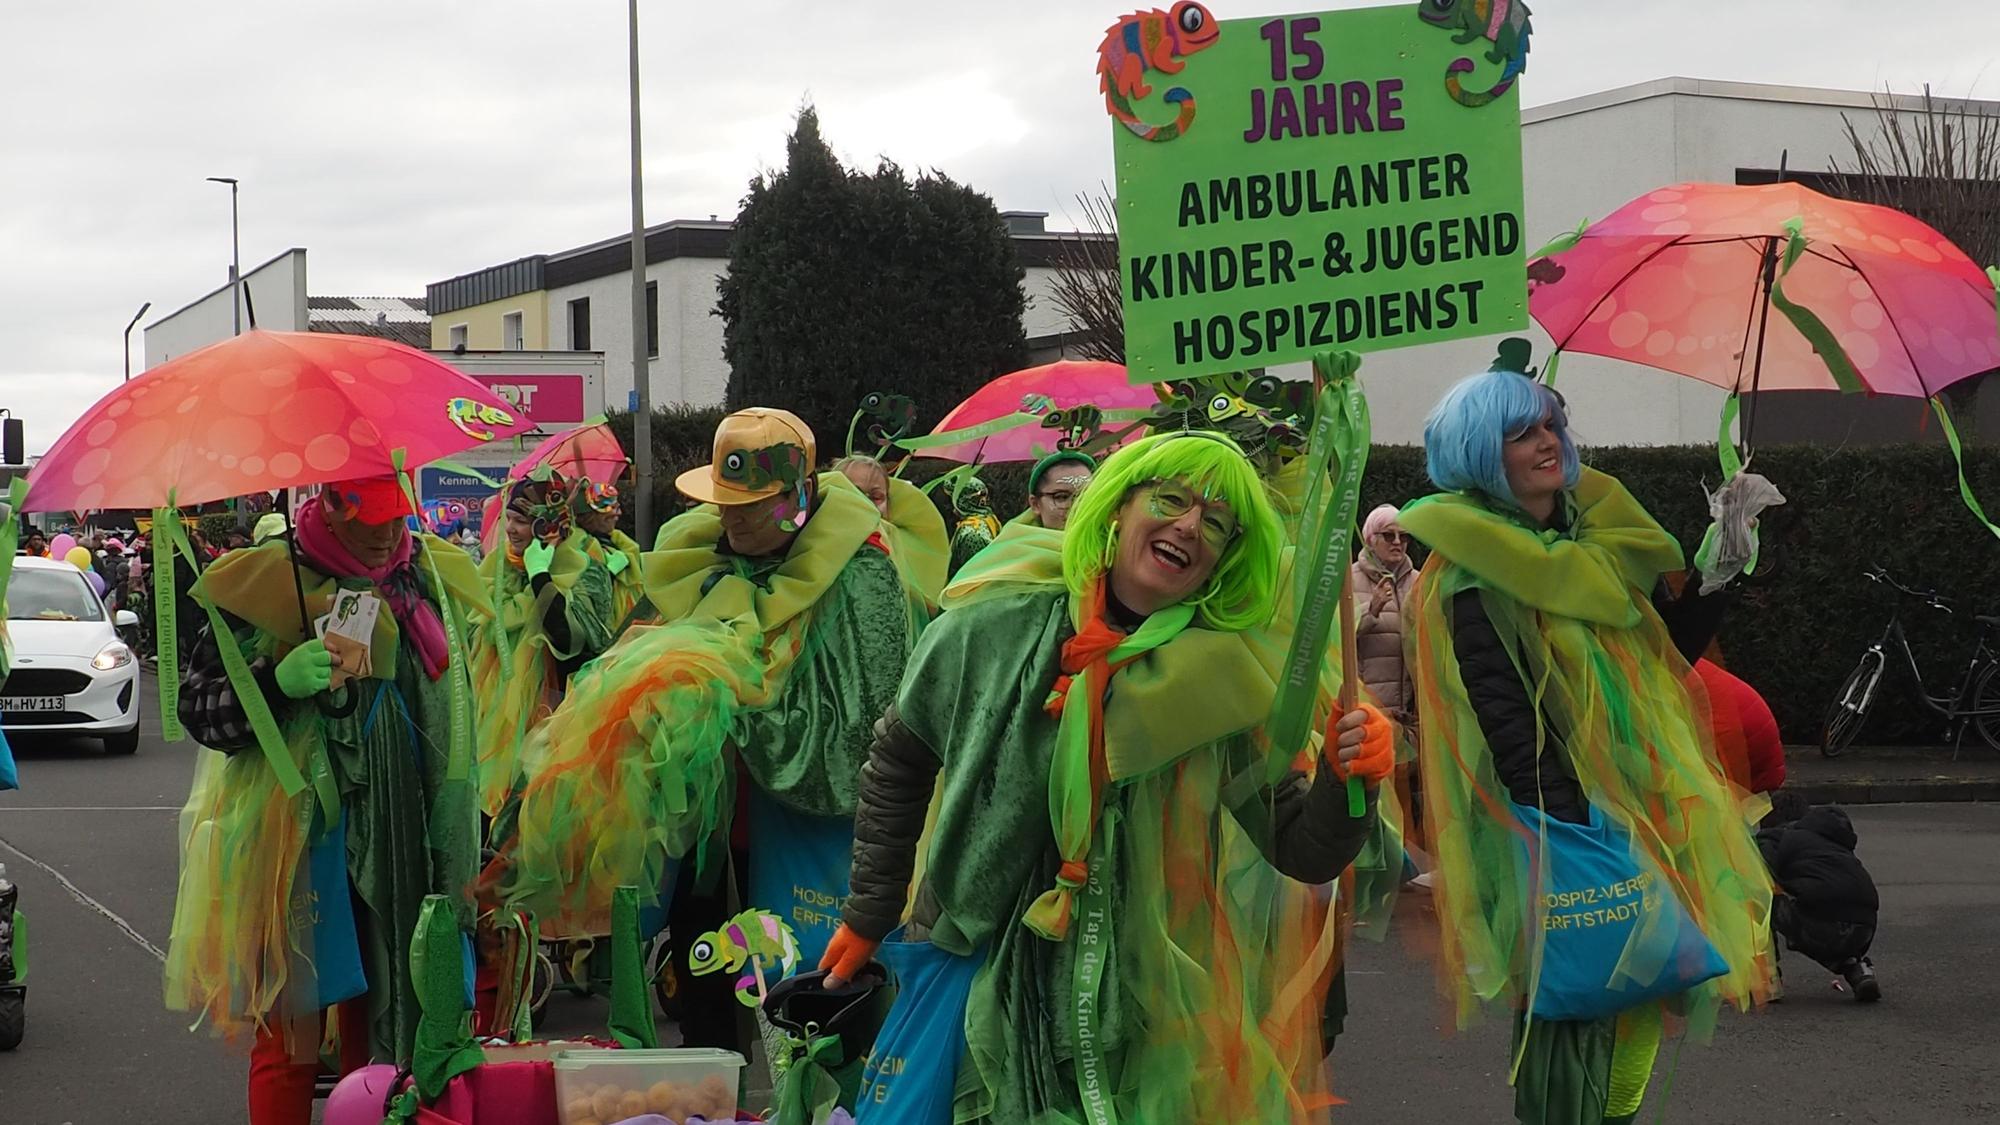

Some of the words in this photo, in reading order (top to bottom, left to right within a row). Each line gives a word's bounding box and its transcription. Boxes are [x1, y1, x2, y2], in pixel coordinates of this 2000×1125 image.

[1260, 16, 1325, 82] 15
[1244, 78, 1405, 144] JAHRE
[1177, 152, 1471, 228] AMBULANTER
[1173, 280, 1485, 366] HOSPIZDIENST
[439, 475, 479, 487] Kennen
[1338, 488, 1356, 521] der
[20, 698, 38, 711] HV
[40, 698, 64, 710] 113
[1082, 907, 1104, 946] Tag
[1542, 901, 1640, 930] ERFTSTADT
[1080, 951, 1099, 985] der
